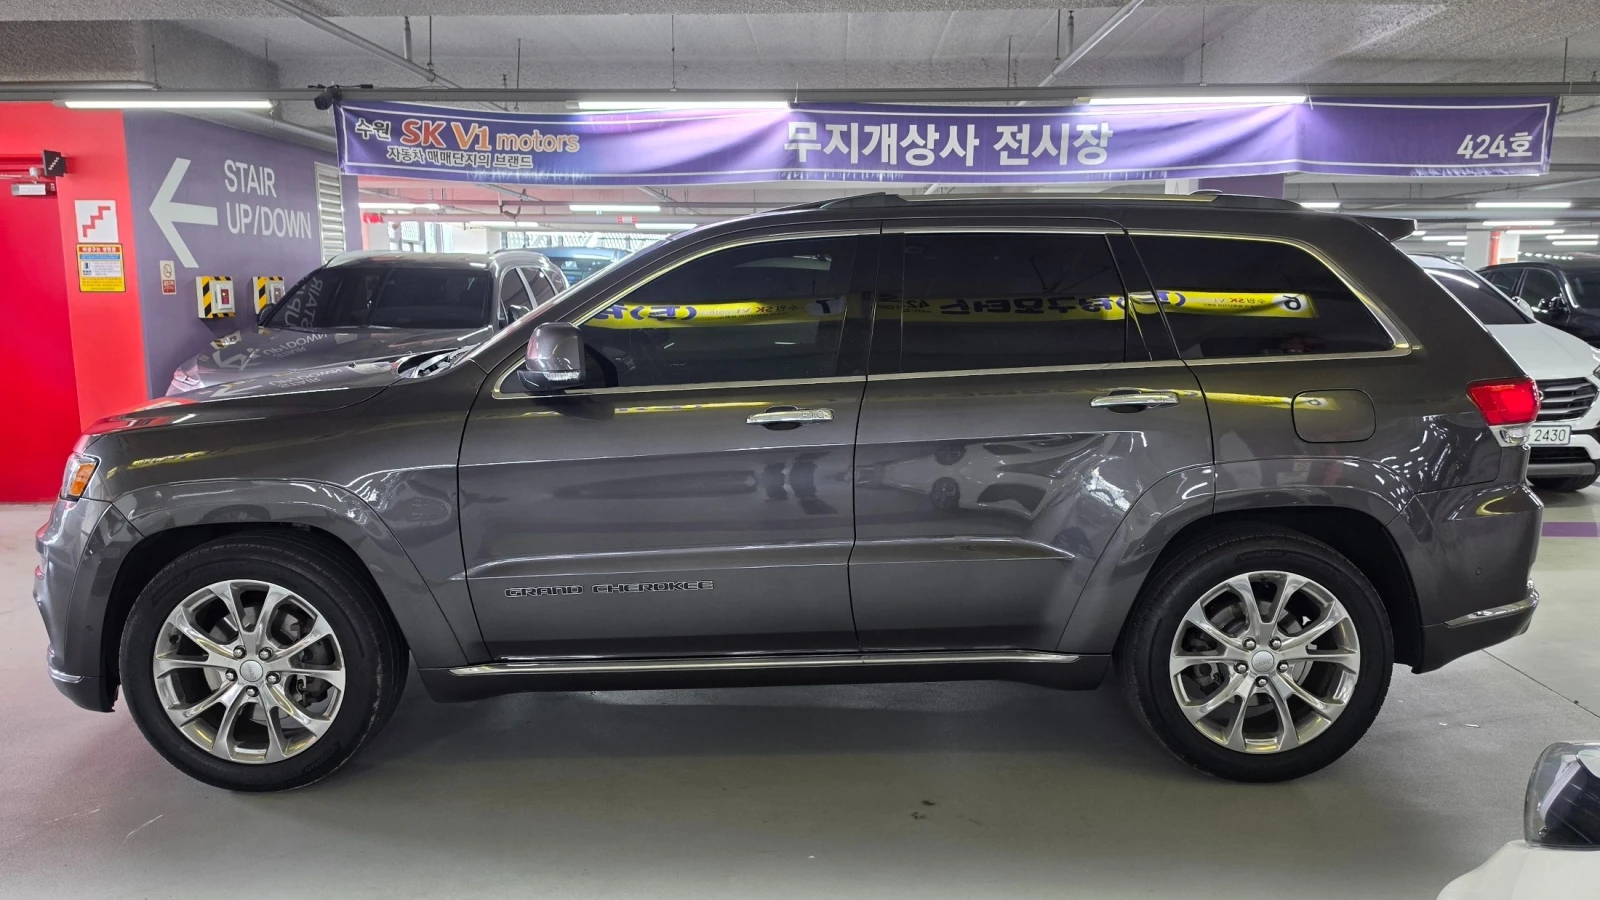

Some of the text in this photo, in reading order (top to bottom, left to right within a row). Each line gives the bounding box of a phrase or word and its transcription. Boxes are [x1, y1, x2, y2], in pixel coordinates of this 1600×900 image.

[355, 118, 580, 153] 수원 SK V1 motors
[784, 121, 1113, 167] 무지개상사 전시장
[1457, 132, 1532, 159] 424호
[387, 145, 533, 169] 자동차 매매단지의 브랜드
[224, 158, 277, 198] STAIR
[226, 201, 312, 240] UP/DOWN
[1534, 429, 1566, 442] 2430
[505, 581, 713, 597] GRAND CHEROKEE
